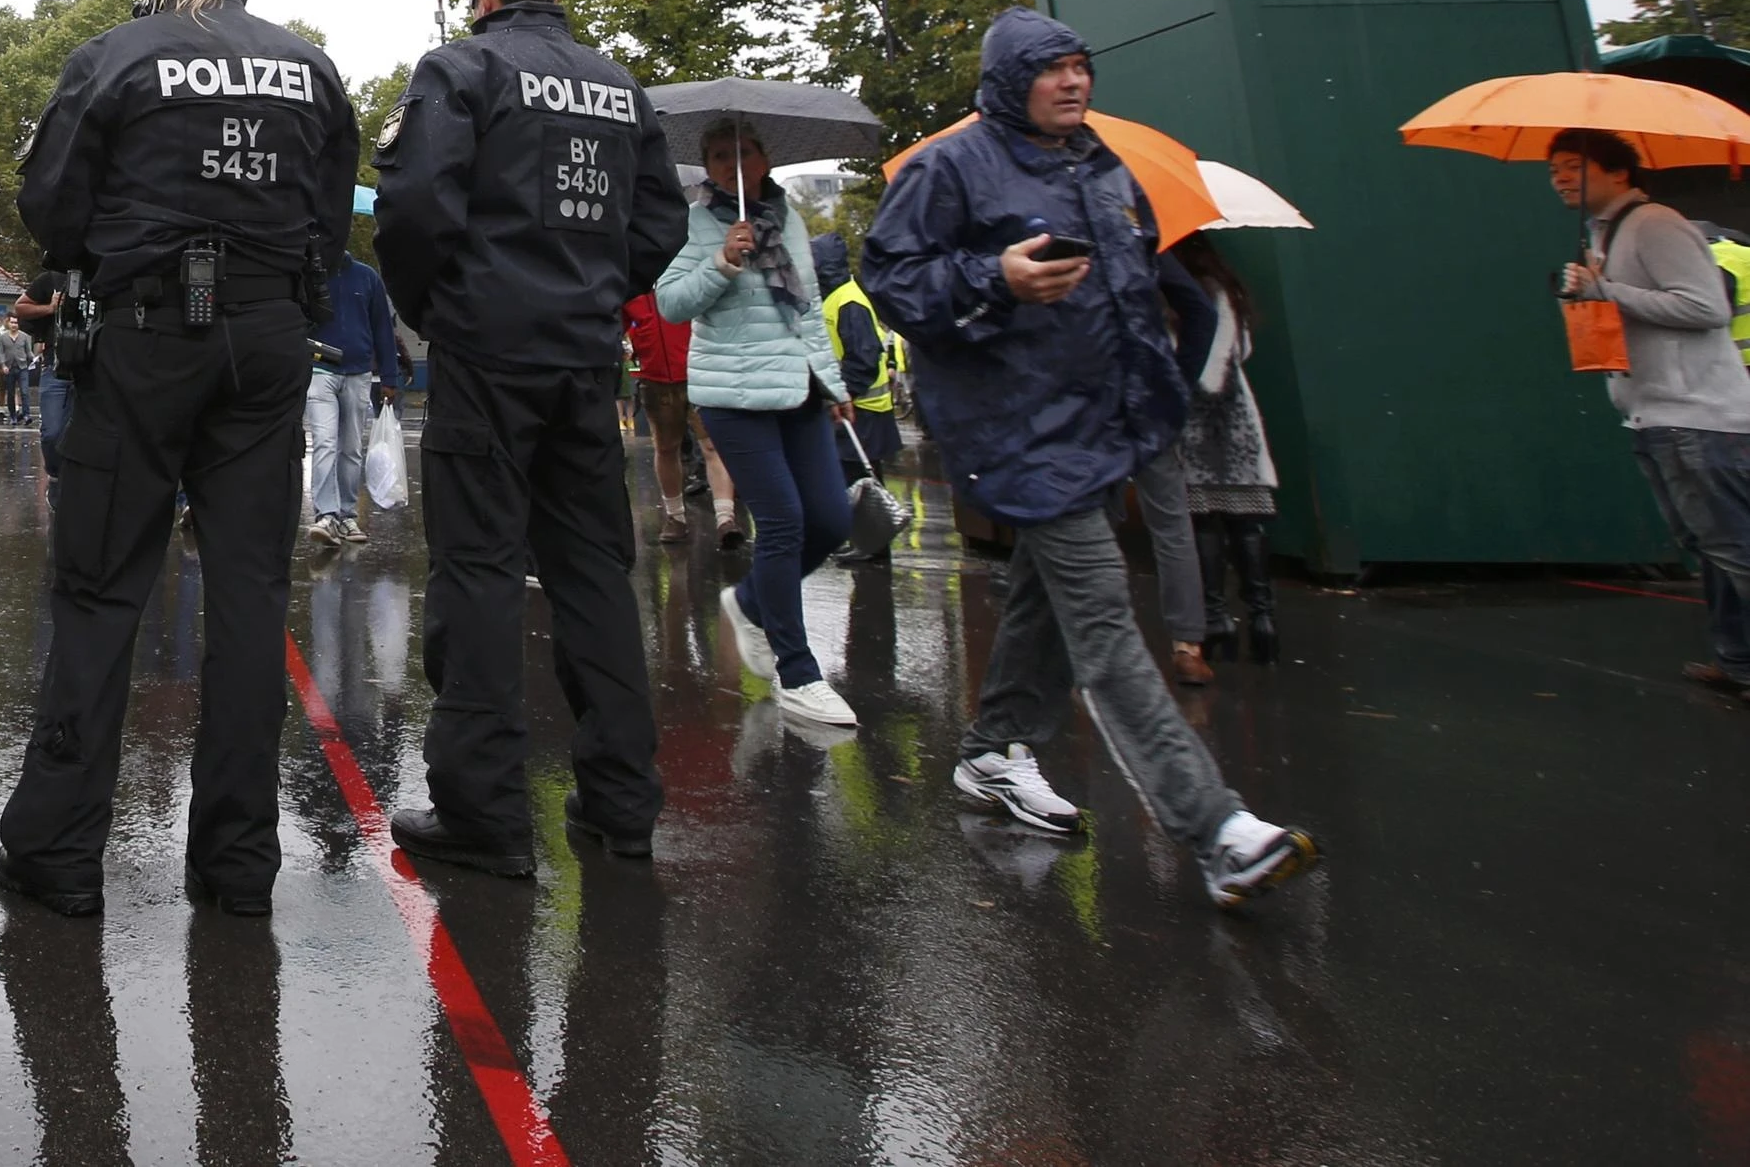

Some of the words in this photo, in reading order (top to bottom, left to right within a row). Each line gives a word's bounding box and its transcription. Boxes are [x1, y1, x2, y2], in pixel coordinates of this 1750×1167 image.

[157, 57, 314, 103] POLIZEI
[519, 71, 637, 124] POLIZEI
[222, 117, 264, 148] BY
[200, 149, 278, 182] 5431
[570, 137, 599, 166] BY
[556, 164, 609, 197] 5430
